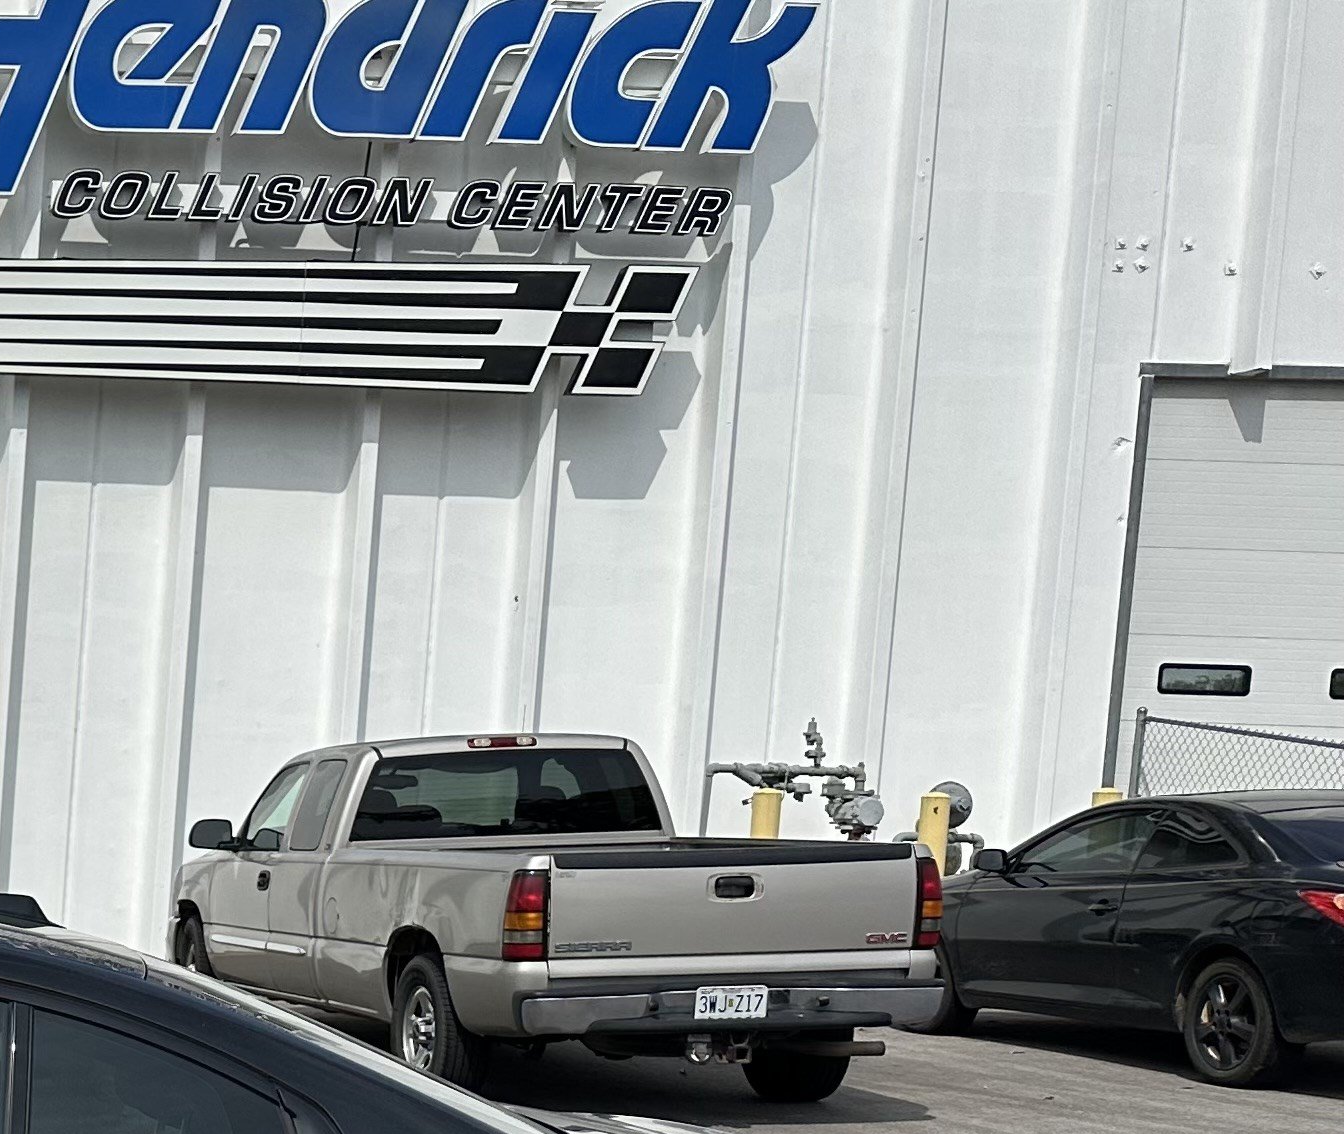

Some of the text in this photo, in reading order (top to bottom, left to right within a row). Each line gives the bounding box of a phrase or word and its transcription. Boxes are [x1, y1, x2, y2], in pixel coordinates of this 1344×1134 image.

[53, 169, 733, 236] COLLISION CENTER
[865, 931, 908, 944] GMC
[698, 993, 764, 1013] 3WJ Z17
